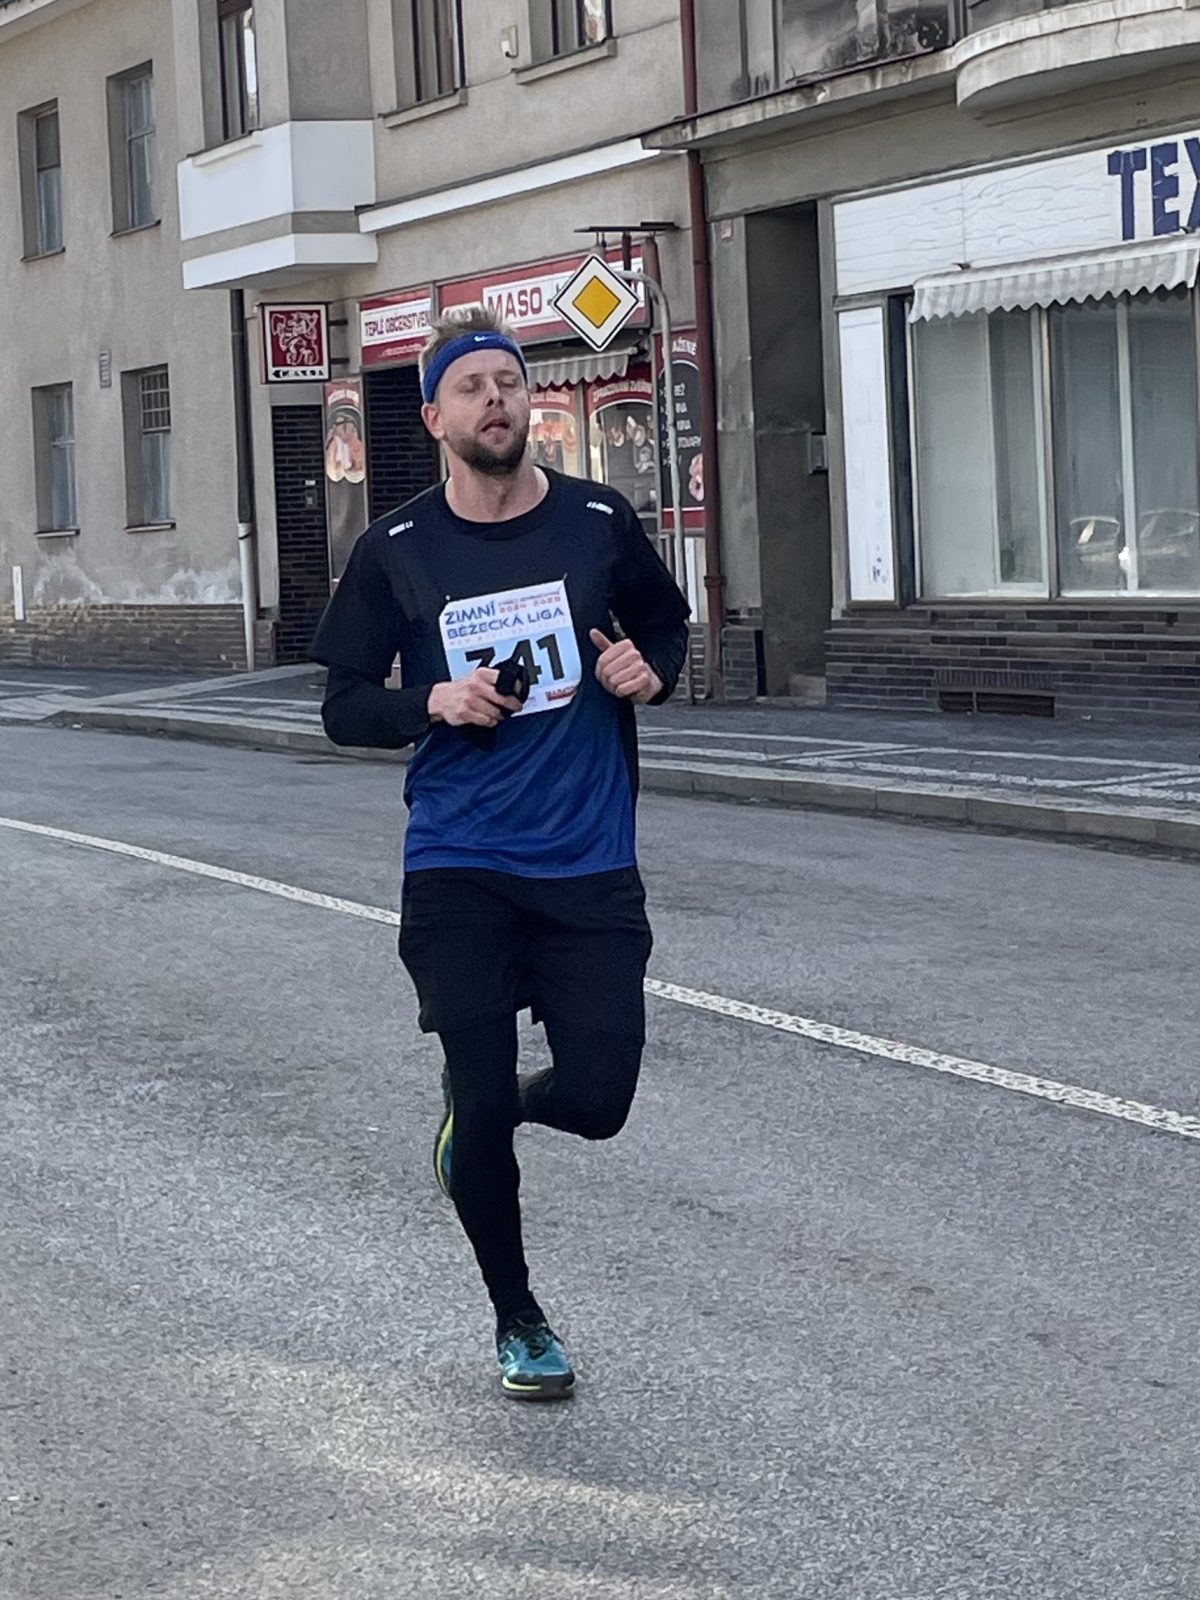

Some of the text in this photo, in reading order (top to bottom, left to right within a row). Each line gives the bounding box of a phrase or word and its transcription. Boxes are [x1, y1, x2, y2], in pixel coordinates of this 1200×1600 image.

[488, 287, 542, 319] MASO
[444, 600, 496, 625] ZIMNÍ
[447, 613, 524, 639] BĚŽECKÁ
[528, 607, 565, 623] LIGA
